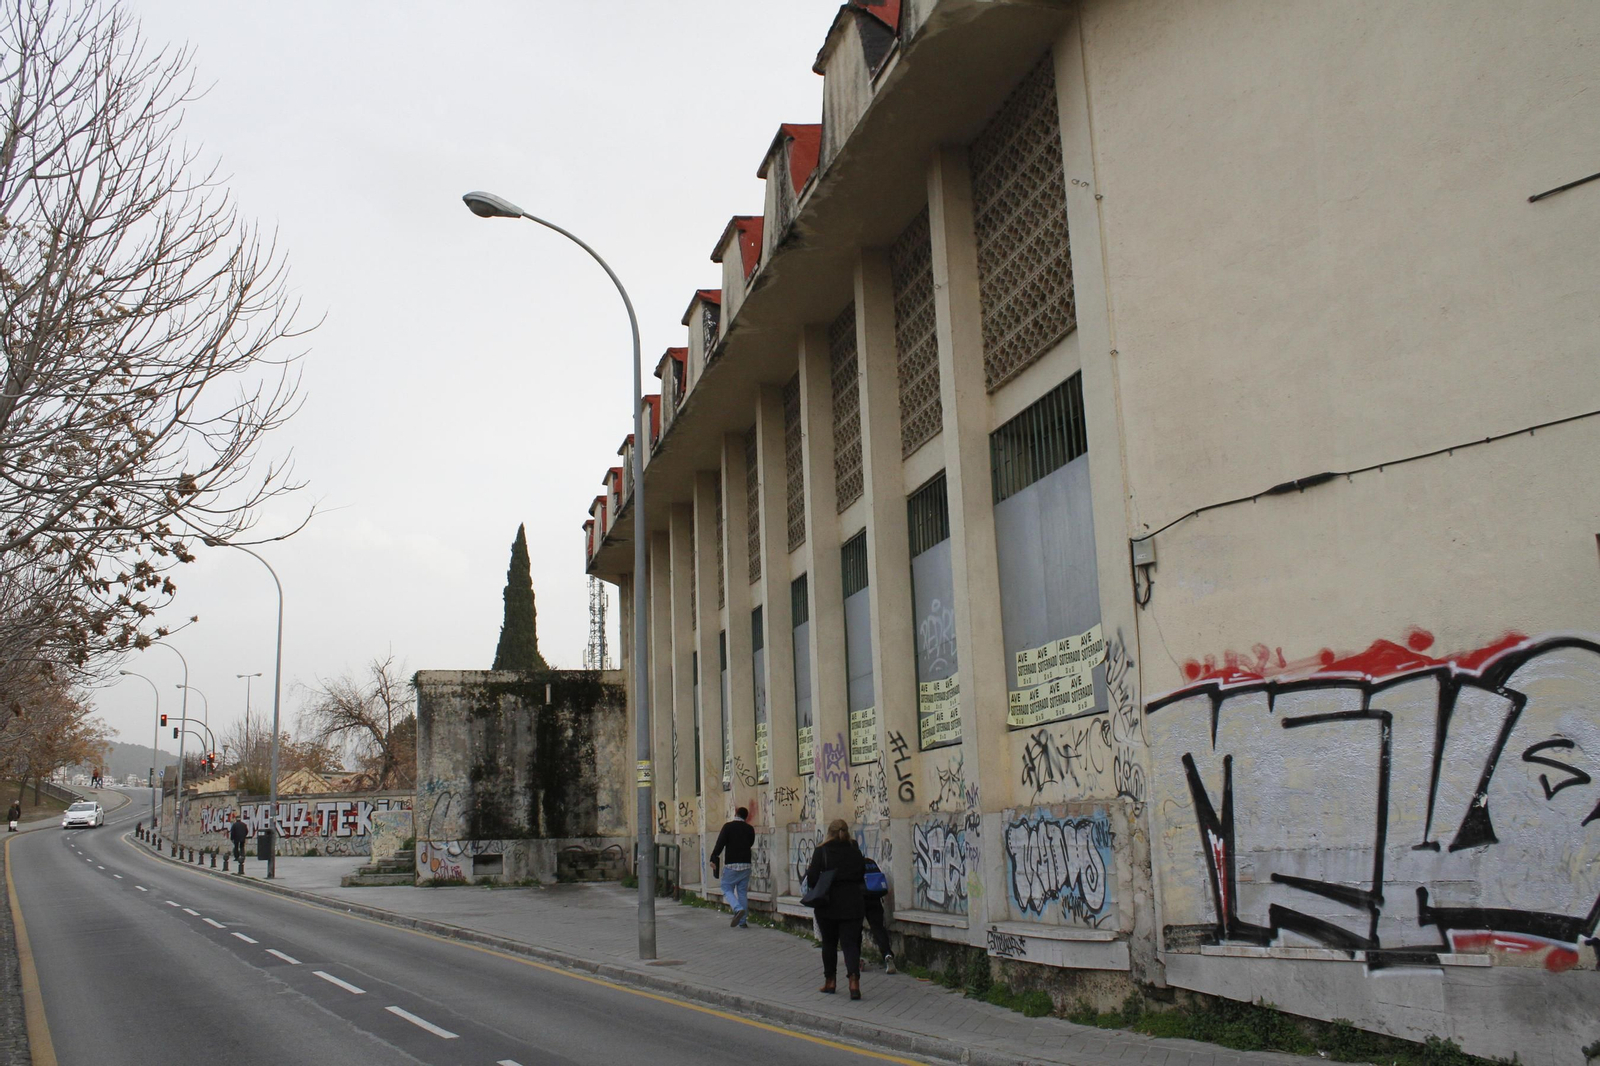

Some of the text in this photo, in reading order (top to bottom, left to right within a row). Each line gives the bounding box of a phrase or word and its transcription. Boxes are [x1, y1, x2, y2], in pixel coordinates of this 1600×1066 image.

[1081, 632, 1092, 646] AVE
[1059, 640, 1070, 652] AVE
[1081, 639, 1103, 661] SOTERRADO
[1018, 653, 1028, 663] AVE
[1037, 647, 1047, 660] AVE
[1059, 650, 1081, 666] SOTERRADO
[1018, 663, 1037, 677] SOTERRADO
[1038, 655, 1058, 673] SOTERRADO
[1049, 682, 1060, 694] AVE
[1071, 675, 1082, 689] AVE
[1011, 693, 1021, 703] AVE
[1029, 689, 1039, 701] AVE
